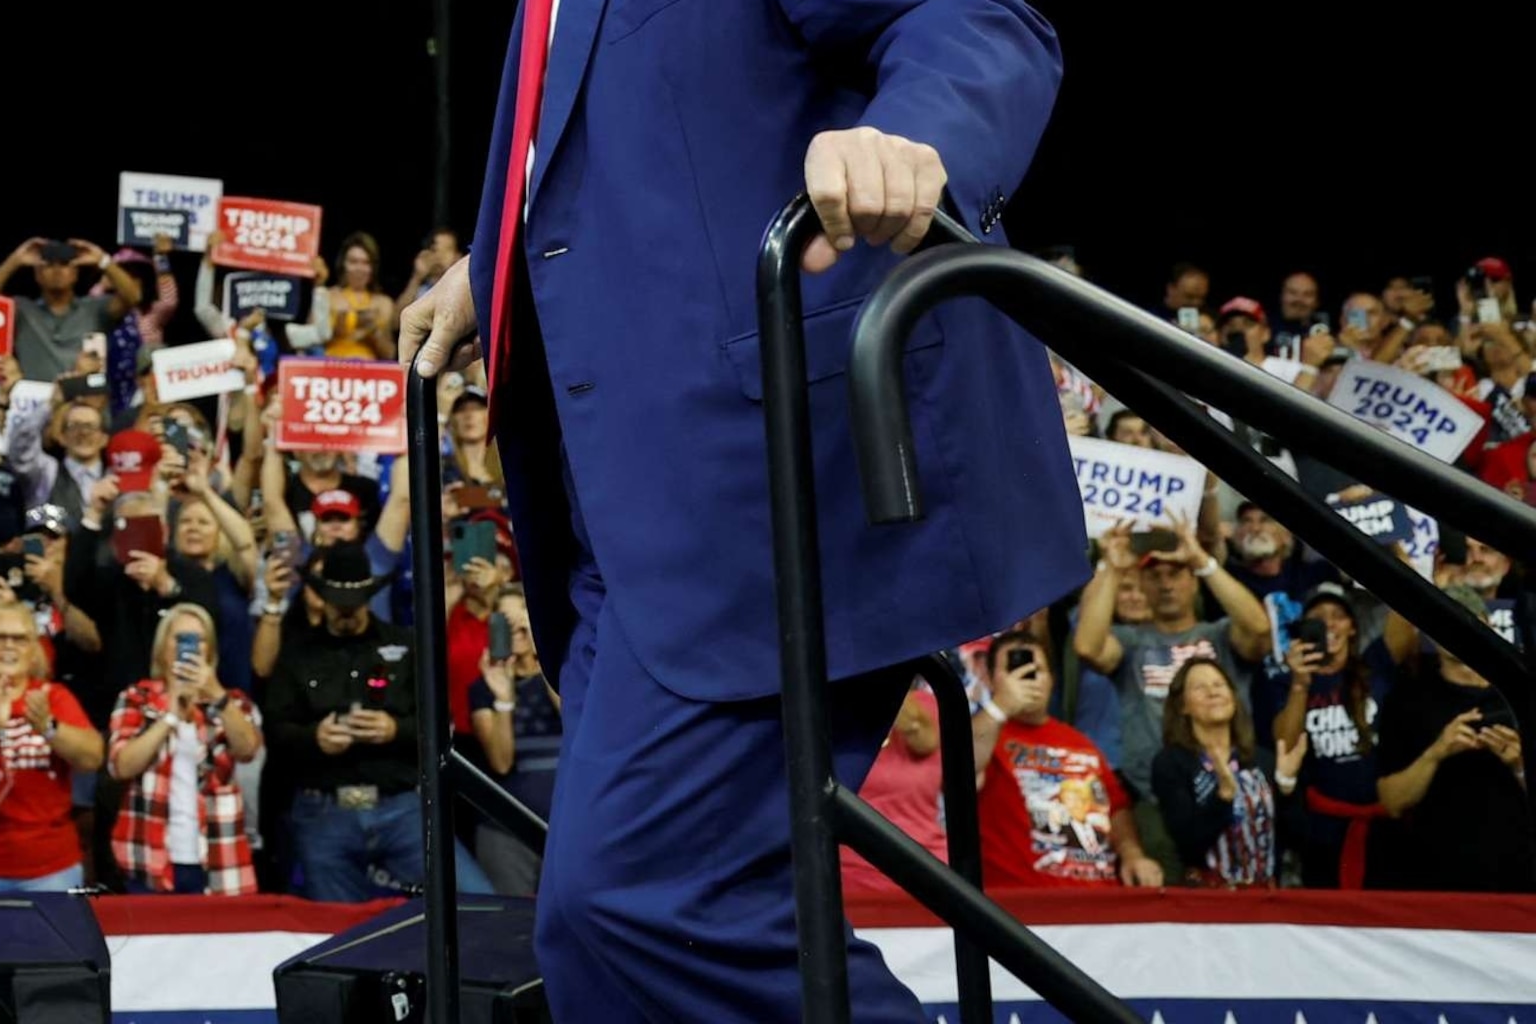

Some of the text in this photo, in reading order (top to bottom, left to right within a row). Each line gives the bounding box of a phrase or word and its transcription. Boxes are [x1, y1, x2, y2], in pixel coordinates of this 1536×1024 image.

[133, 189, 210, 208] TRUMP
[224, 208, 311, 235] TRUMP
[235, 227, 297, 251] 2024
[166, 362, 233, 384] TRUMP
[290, 376, 398, 403] TRUMP
[303, 399, 382, 425] 2024
[1352, 376, 1457, 435] TRUMP
[1353, 398, 1431, 445] 2024
[1074, 458, 1185, 495] TRUMP
[1083, 484, 1163, 517] 2024
[1336, 499, 1395, 523] UMP
